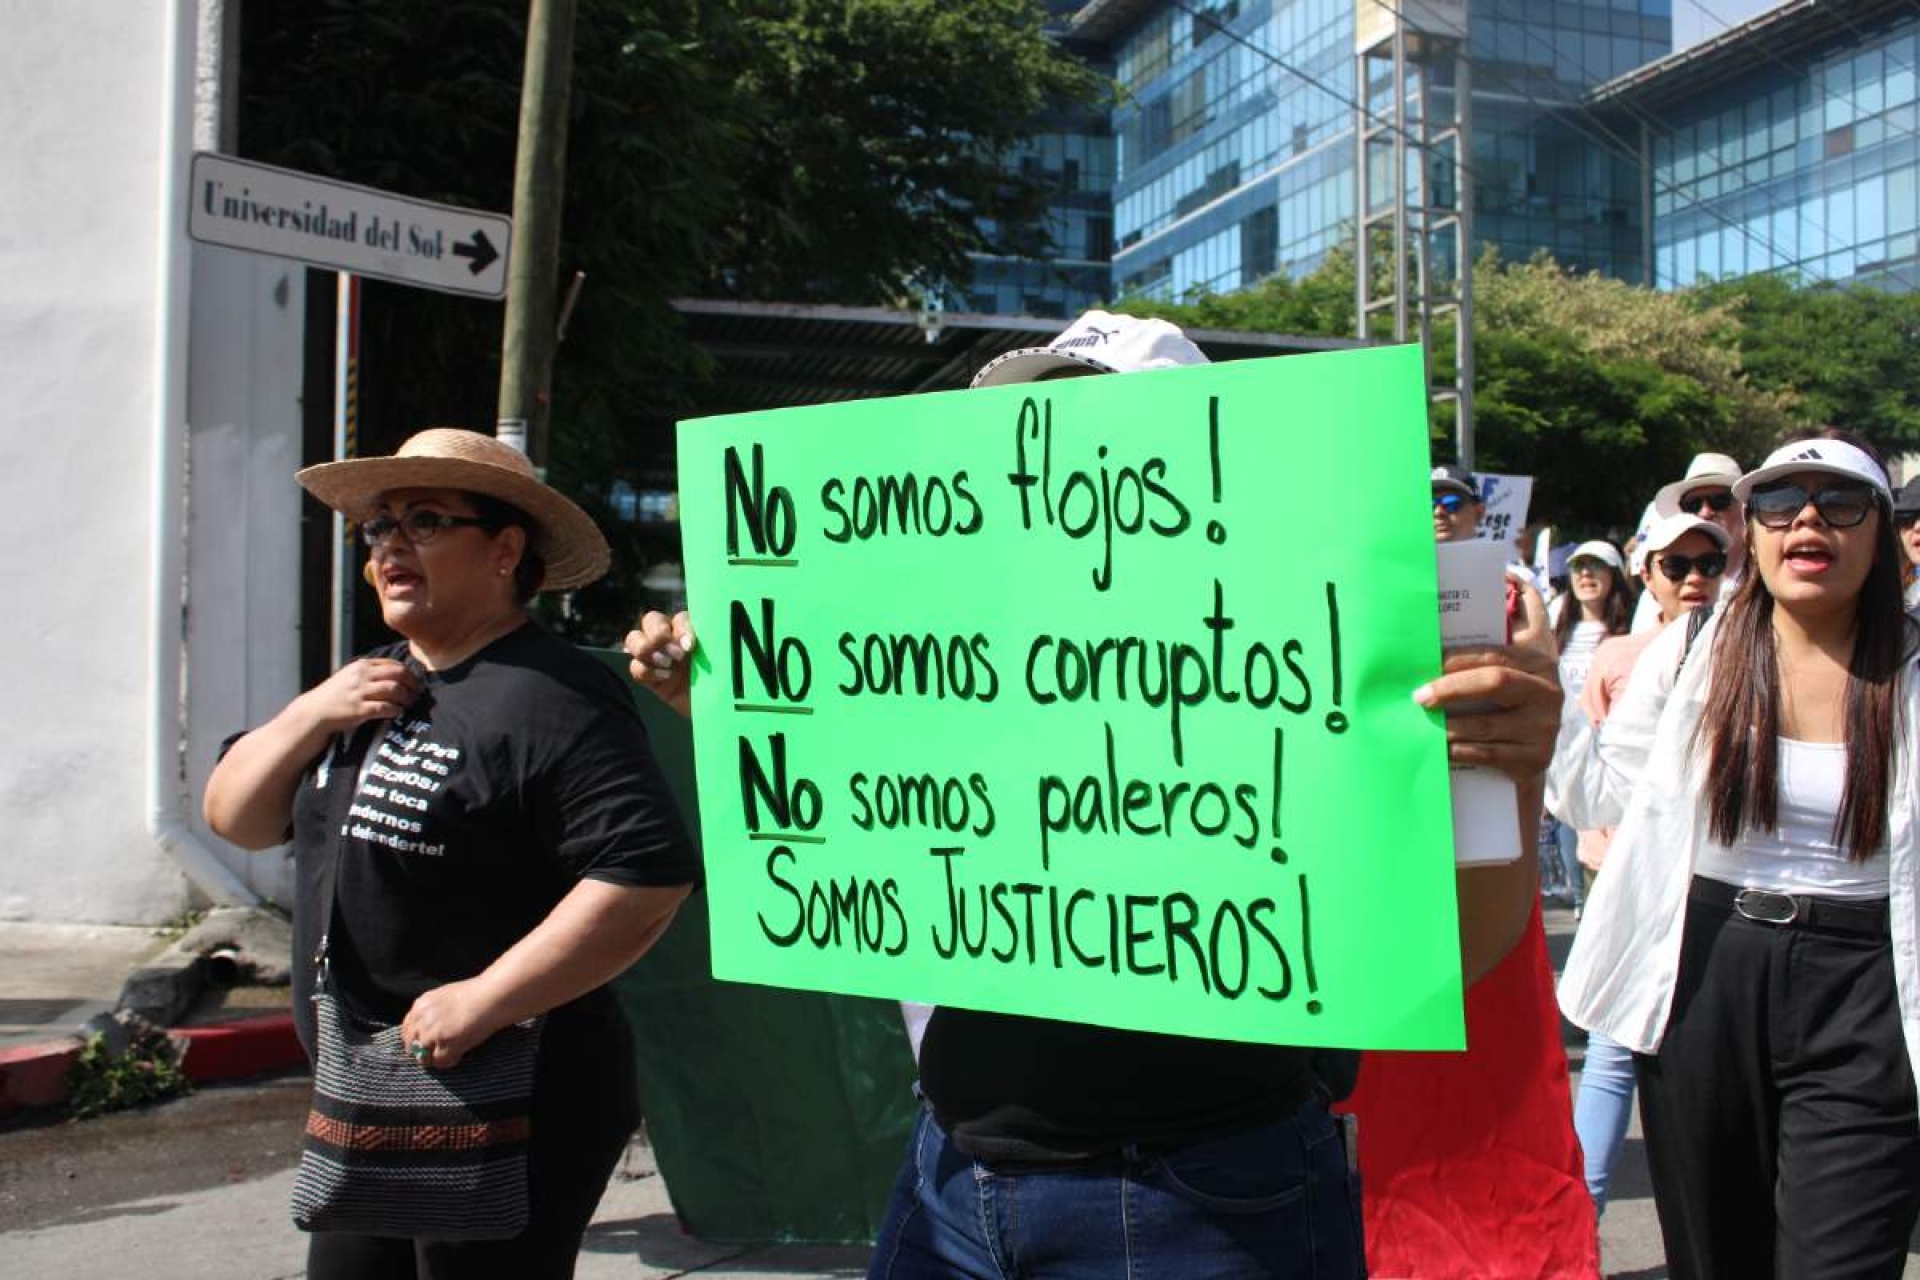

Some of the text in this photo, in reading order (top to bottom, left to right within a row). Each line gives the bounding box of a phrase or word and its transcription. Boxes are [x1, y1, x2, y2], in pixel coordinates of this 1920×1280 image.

[204, 180, 442, 260] Universidad del Sol
[725, 397, 1225, 590] No somos flojos!
[731, 580, 1346, 766] No somos corruptos!
[389, 789, 428, 811] toca
[739, 724, 1286, 870] No somos paleros!
[931, 848, 1319, 1013] JUSTICIEROS!
